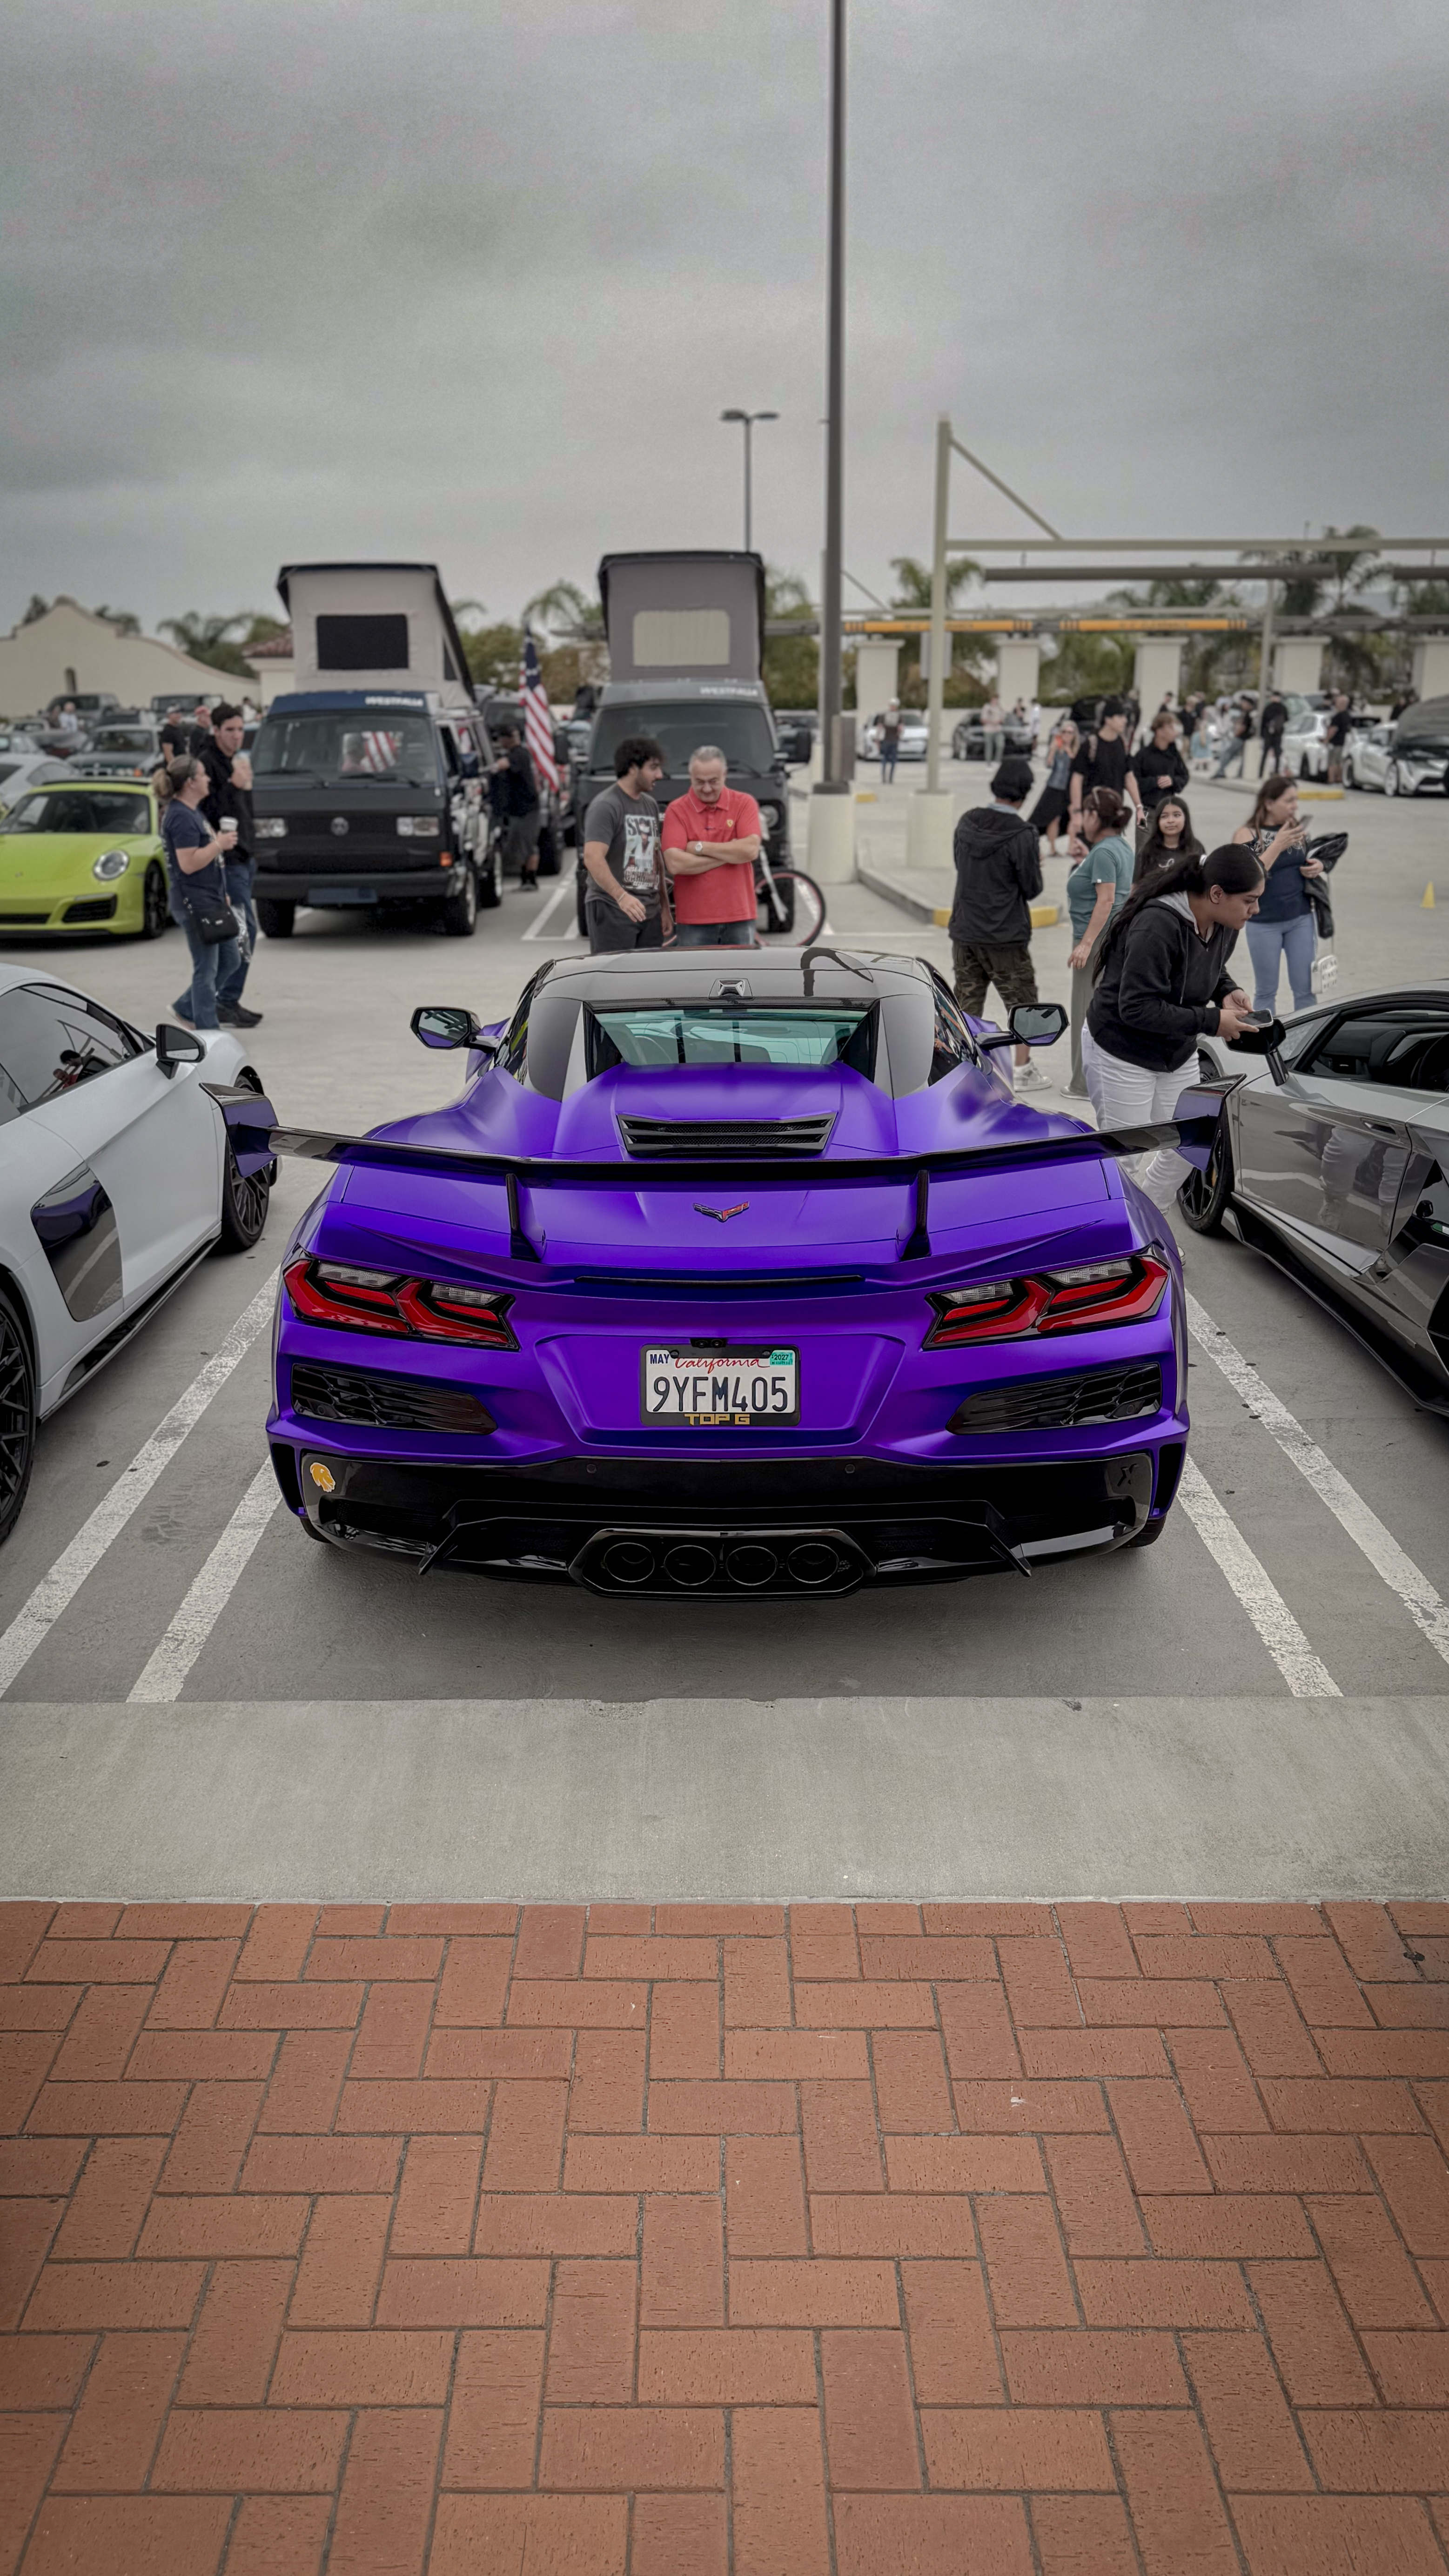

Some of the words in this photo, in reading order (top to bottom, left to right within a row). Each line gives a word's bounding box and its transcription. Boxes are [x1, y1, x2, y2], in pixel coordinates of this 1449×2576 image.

[650, 1354, 669, 1364] MAY
[675, 1358, 770, 1374] California
[653, 1376, 788, 1412] 9YFM405
[684, 1414, 730, 1425] TOP
[735, 1414, 750, 1425] G
